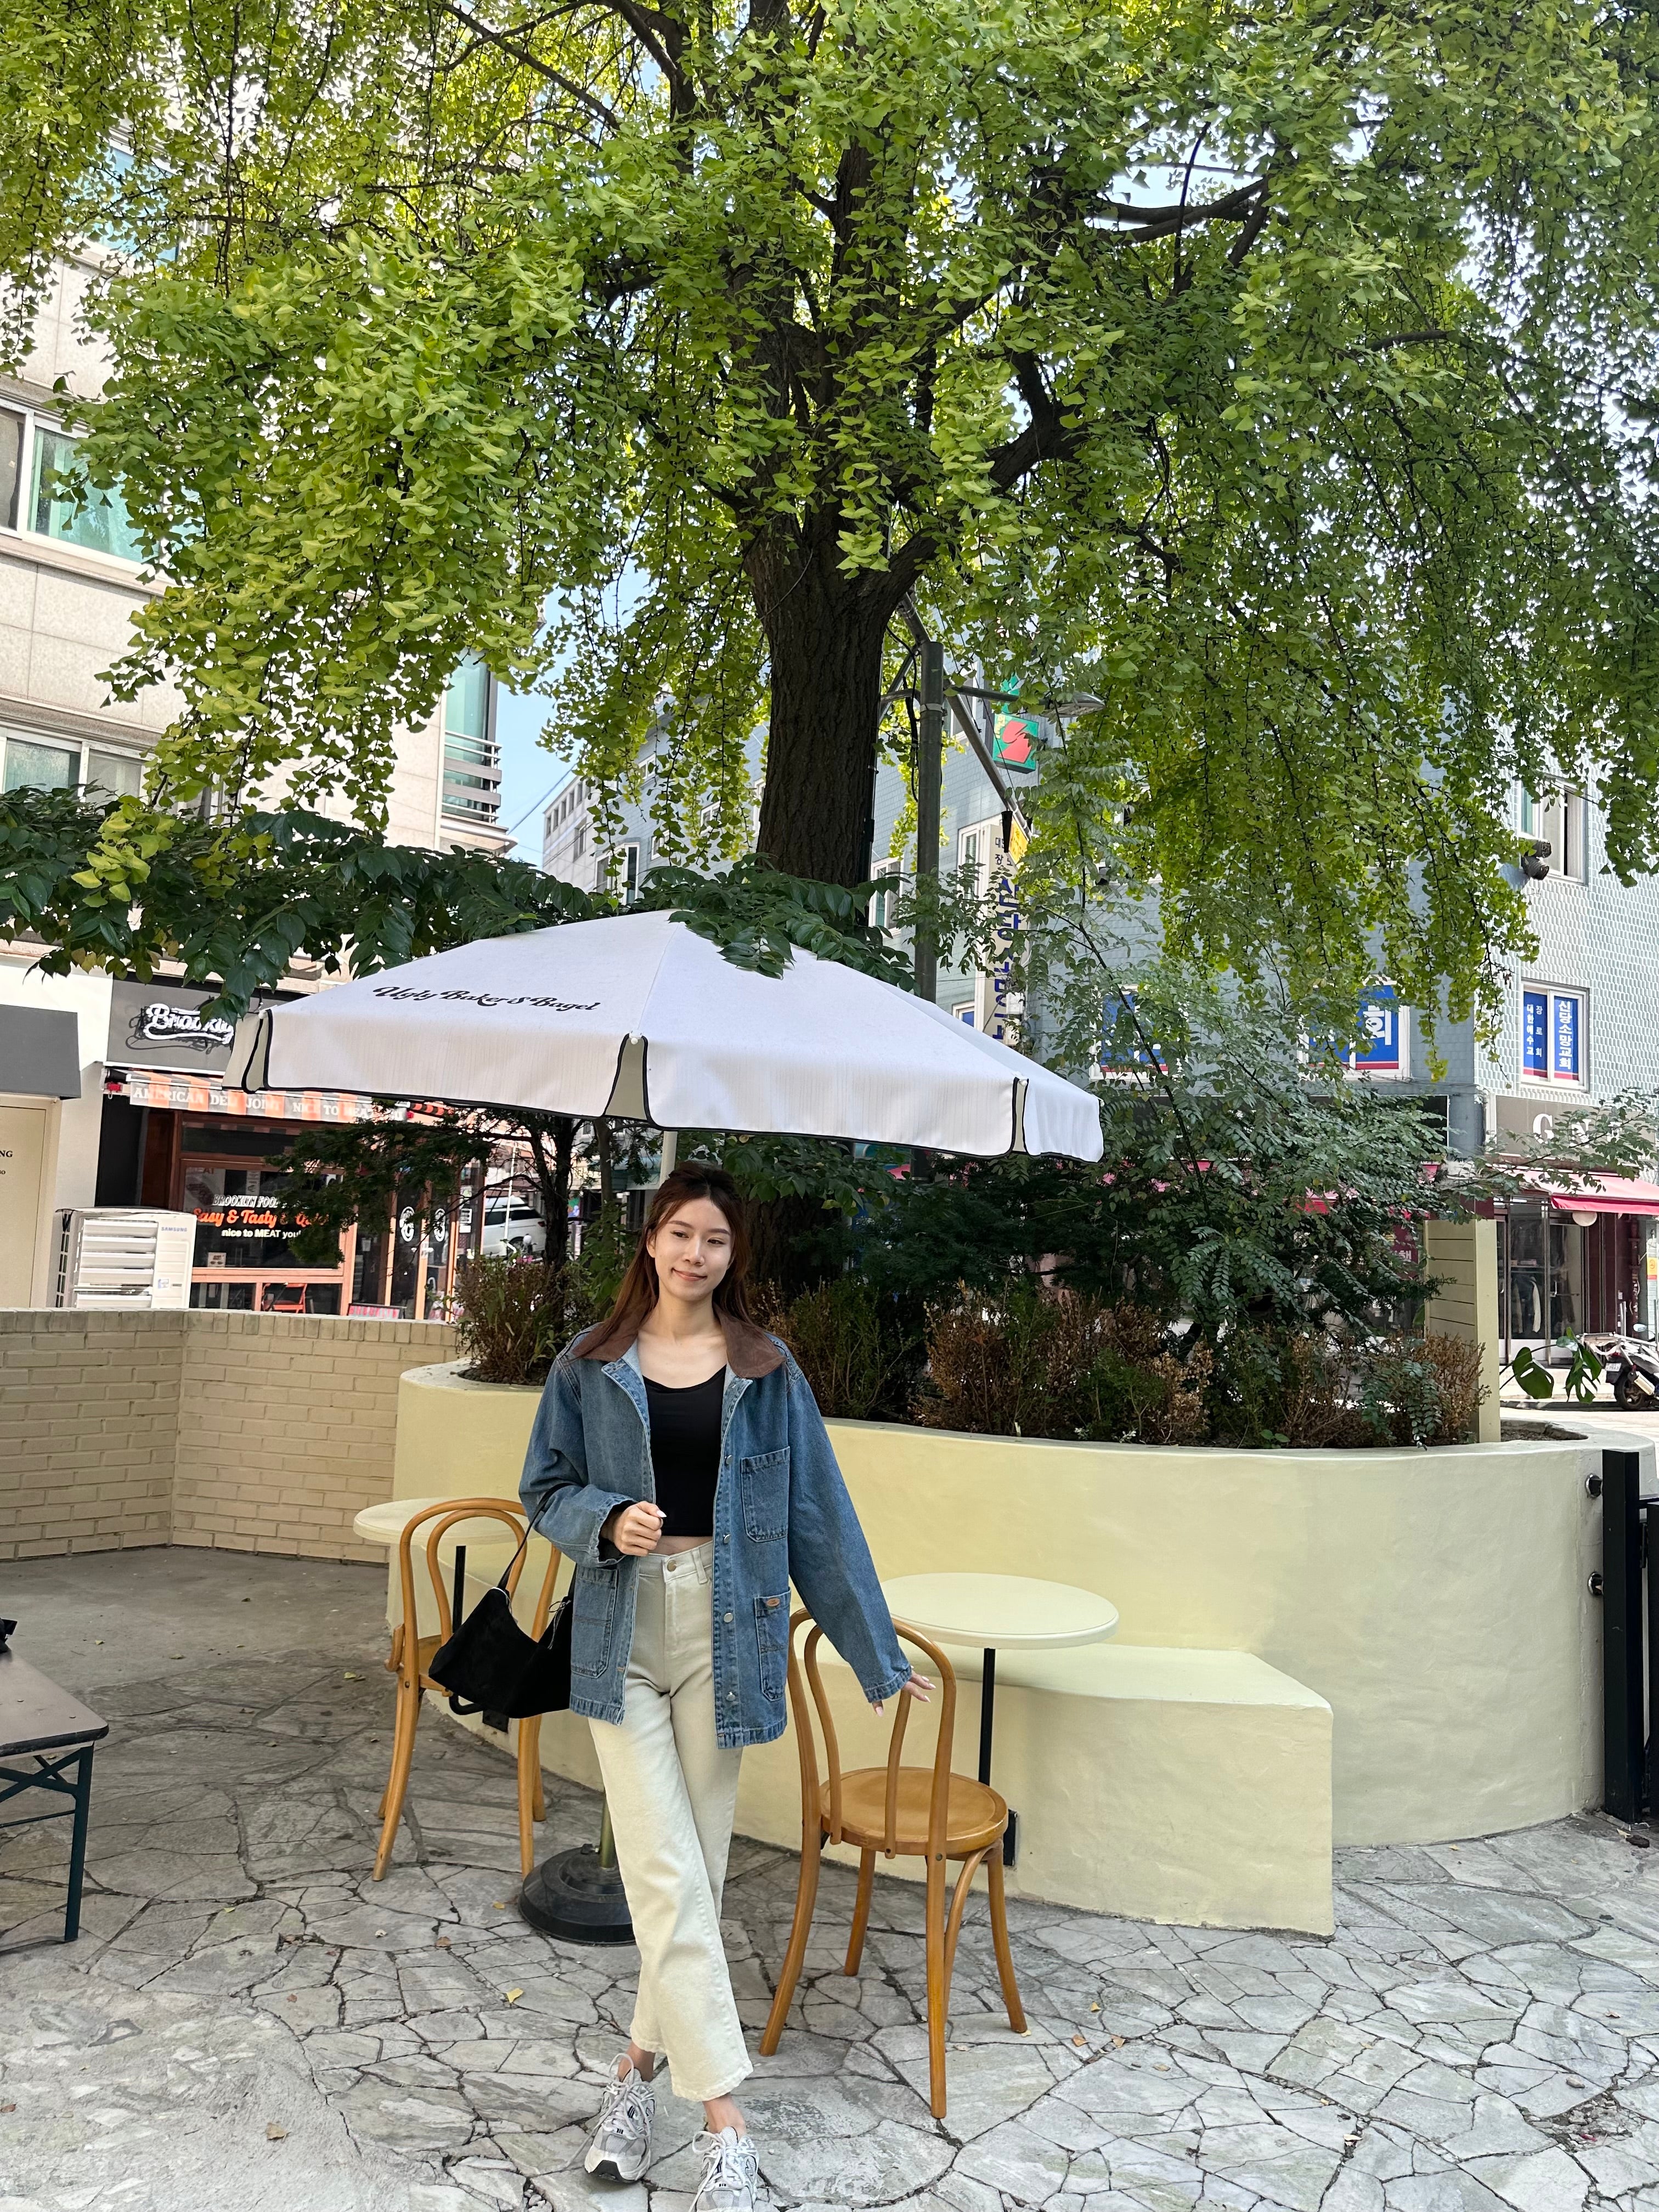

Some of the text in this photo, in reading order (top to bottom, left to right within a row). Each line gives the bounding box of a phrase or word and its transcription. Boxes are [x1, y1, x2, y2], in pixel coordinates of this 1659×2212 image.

[373, 986, 438, 1001] Ugly
[438, 990, 509, 1006] Baker
[528, 997, 601, 1011] Bagel
[1559, 1001, 1572, 1069] 신당소망교회
[133, 1087, 204, 1104] AMERICAN
[210, 1094, 237, 1107] DELI
[246, 1097, 280, 1110] JOINT
[323, 1104, 340, 1115] TO
[227, 1209, 239, 1224] &
[240, 1210, 278, 1229] Tasty
[221, 1228, 242, 1237] nice
[242, 1229, 253, 1238] to
[254, 1229, 281, 1238] MEAT
